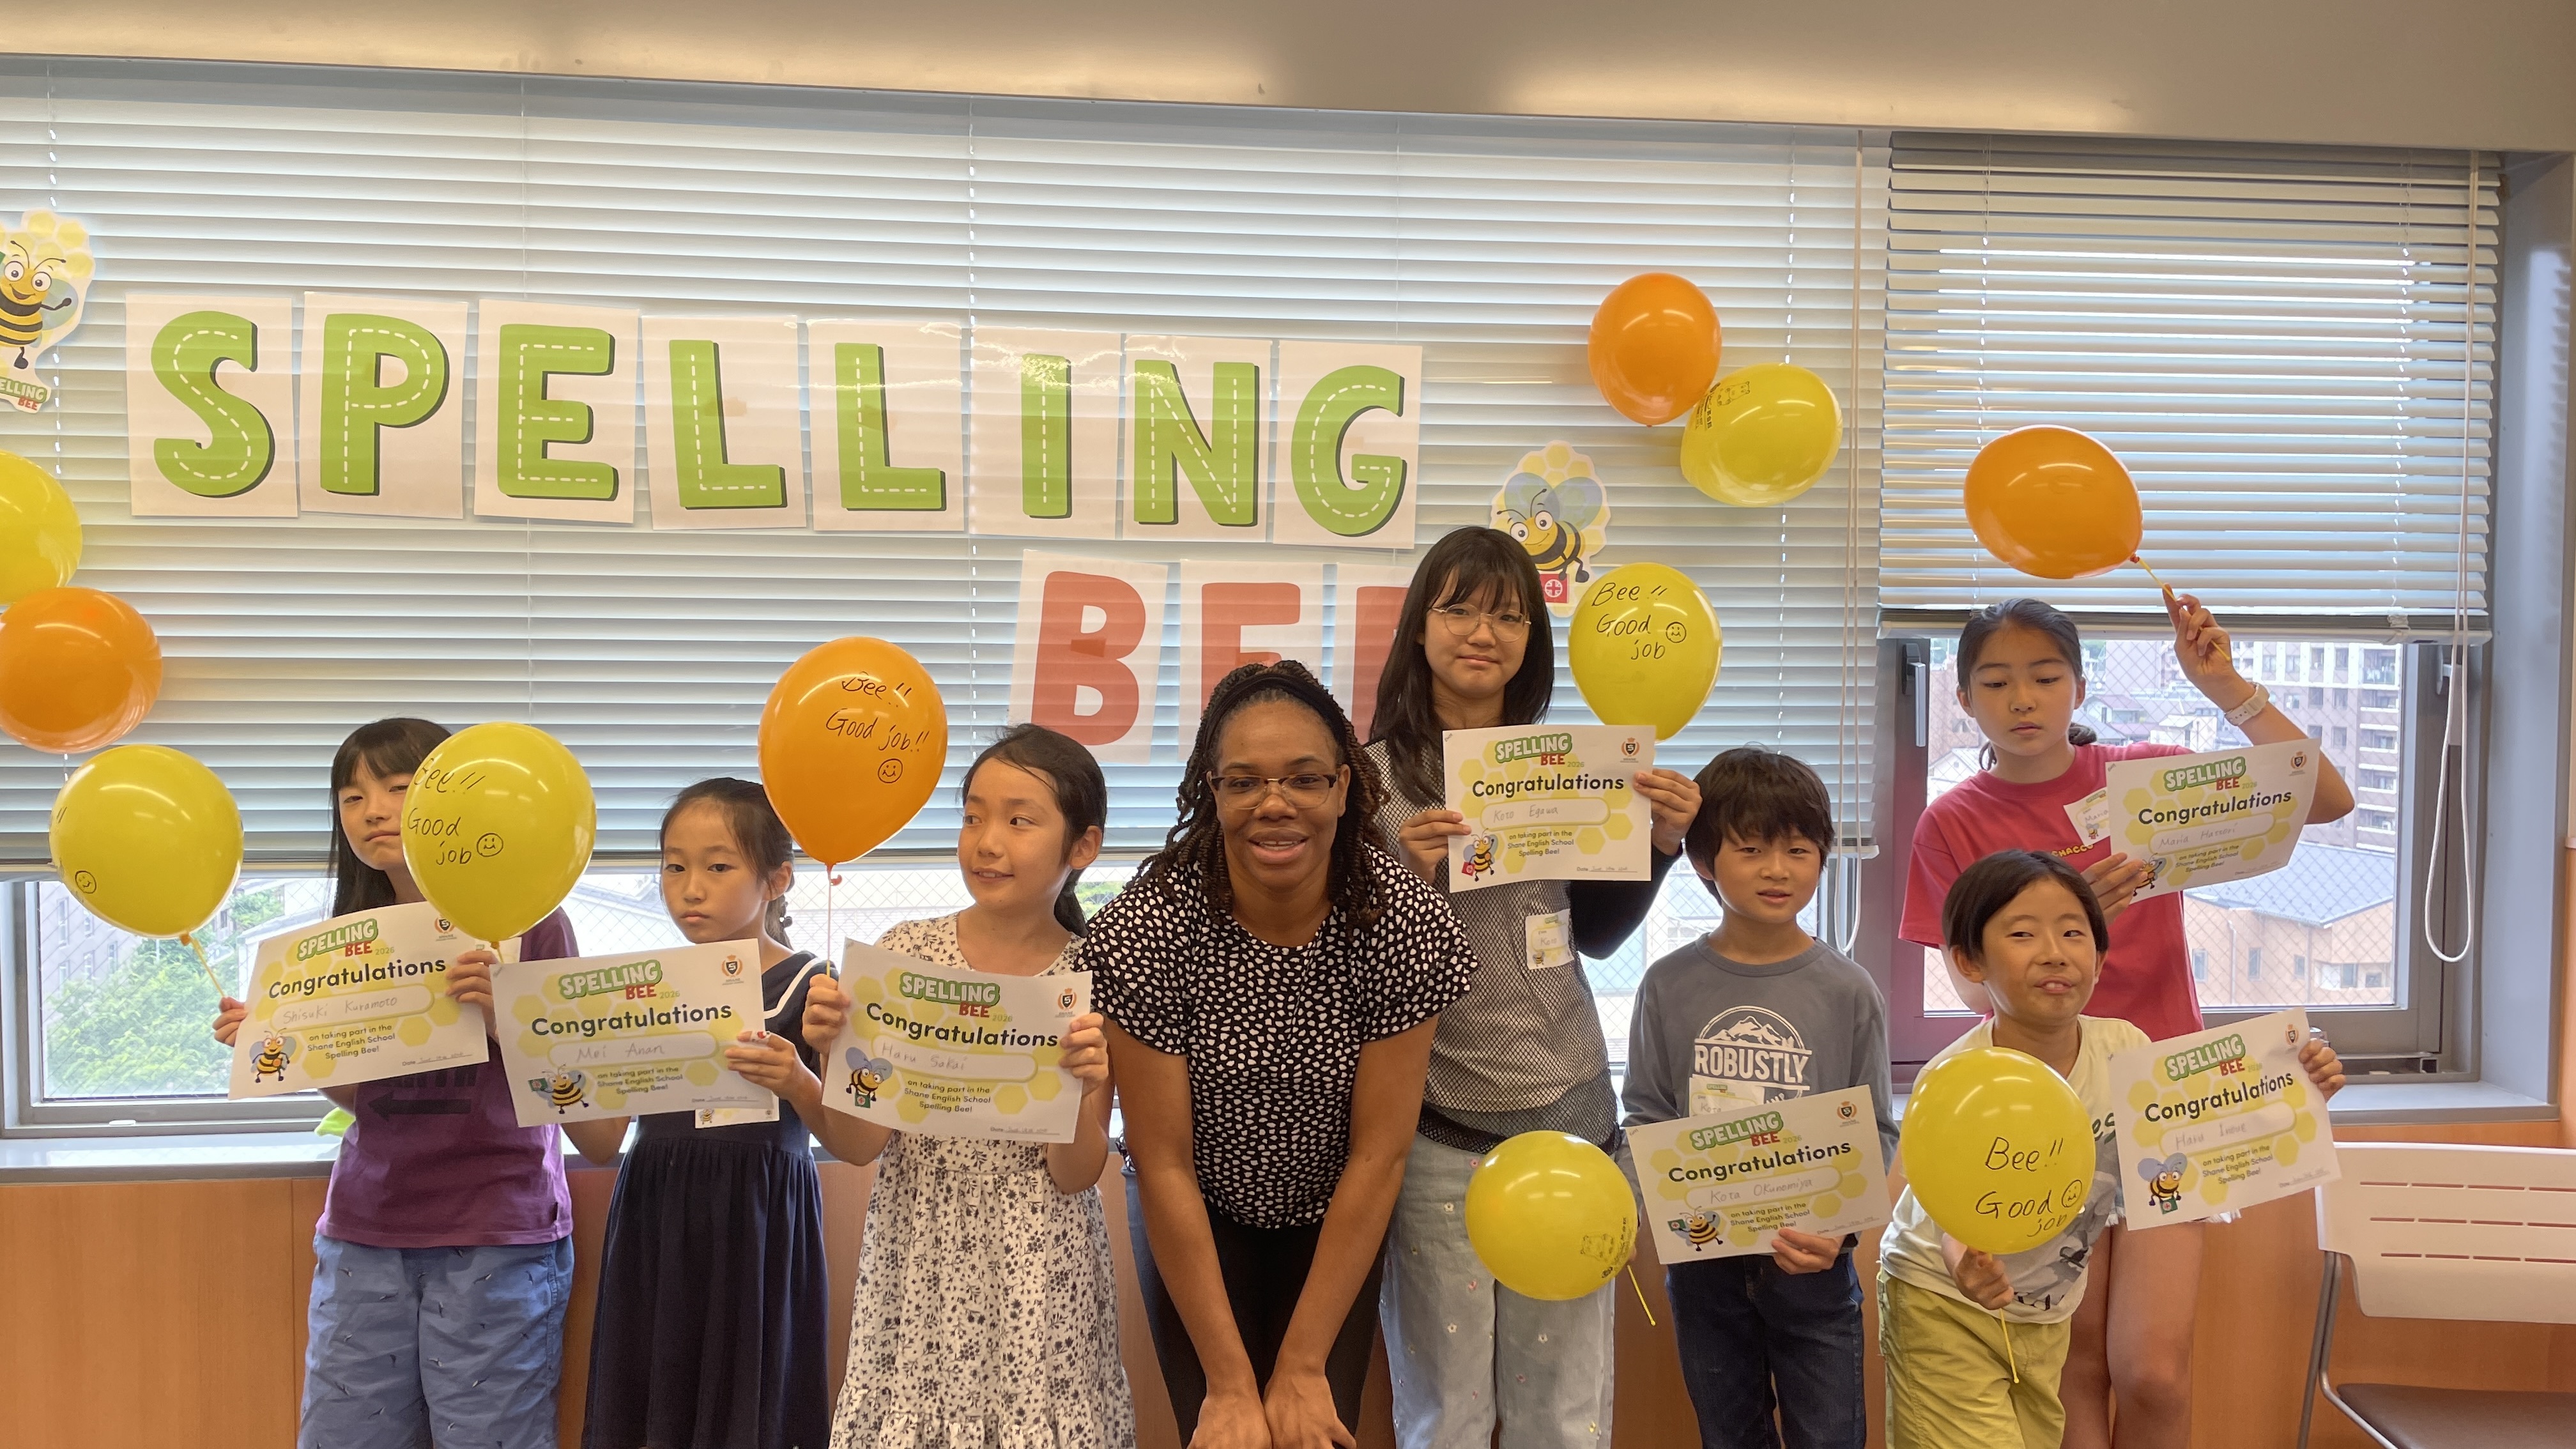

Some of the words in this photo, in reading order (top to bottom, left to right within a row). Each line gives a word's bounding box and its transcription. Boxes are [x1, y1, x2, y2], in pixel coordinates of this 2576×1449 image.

[18, 396, 37, 410] BEE
[151, 310, 1407, 536] SPELLING
[1597, 614, 1652, 637] Good
[1631, 640, 1666, 660] job
[826, 708, 878, 739] Good
[1496, 735, 1569, 760] SPELLING
[1540, 753, 1565, 765] BEE
[1472, 774, 1623, 798] Congratulations
[2165, 759, 2244, 790] SPELLING
[2216, 777, 2240, 791] BEE
[2138, 792, 2292, 825] Congratulations
[408, 808, 461, 837] Good
[436, 841, 471, 865] job
[2159, 834, 2189, 849] Maria
[299, 921, 374, 958] SPELLING
[345, 941, 372, 957] BEE
[375, 947, 395, 955] 2026
[269, 959, 446, 998] Congratulations
[561, 962, 658, 996] SPELLING
[901, 975, 996, 1002] SPELLING
[625, 985, 657, 999] BEE
[659, 991, 680, 999] 2026
[532, 1004, 732, 1037] Congratulations
[959, 1002, 990, 1018] BEE
[321, 1030, 346, 1039] taking
[349, 1028, 367, 1038] part
[866, 1002, 1058, 1047] Congratulations
[308, 1043, 333, 1052] Shane
[336, 1038, 365, 1048] English
[367, 1033, 395, 1043] School
[325, 1049, 358, 1060] Spelling
[577, 1045, 606, 1063] Mei
[1694, 1045, 1809, 1084] ROBUSTLY
[2167, 1036, 2242, 1077] SPELLING
[2220, 1058, 2245, 1076] BEE
[2145, 1072, 2293, 1122] Congratulations
[1692, 1113, 1779, 1148] SPELLING
[1751, 1131, 1779, 1147] BEE
[1669, 1142, 1850, 1182] Congratulations
[1710, 1190, 1741, 1204] Kota
[1975, 1190, 2053, 1220] Good
